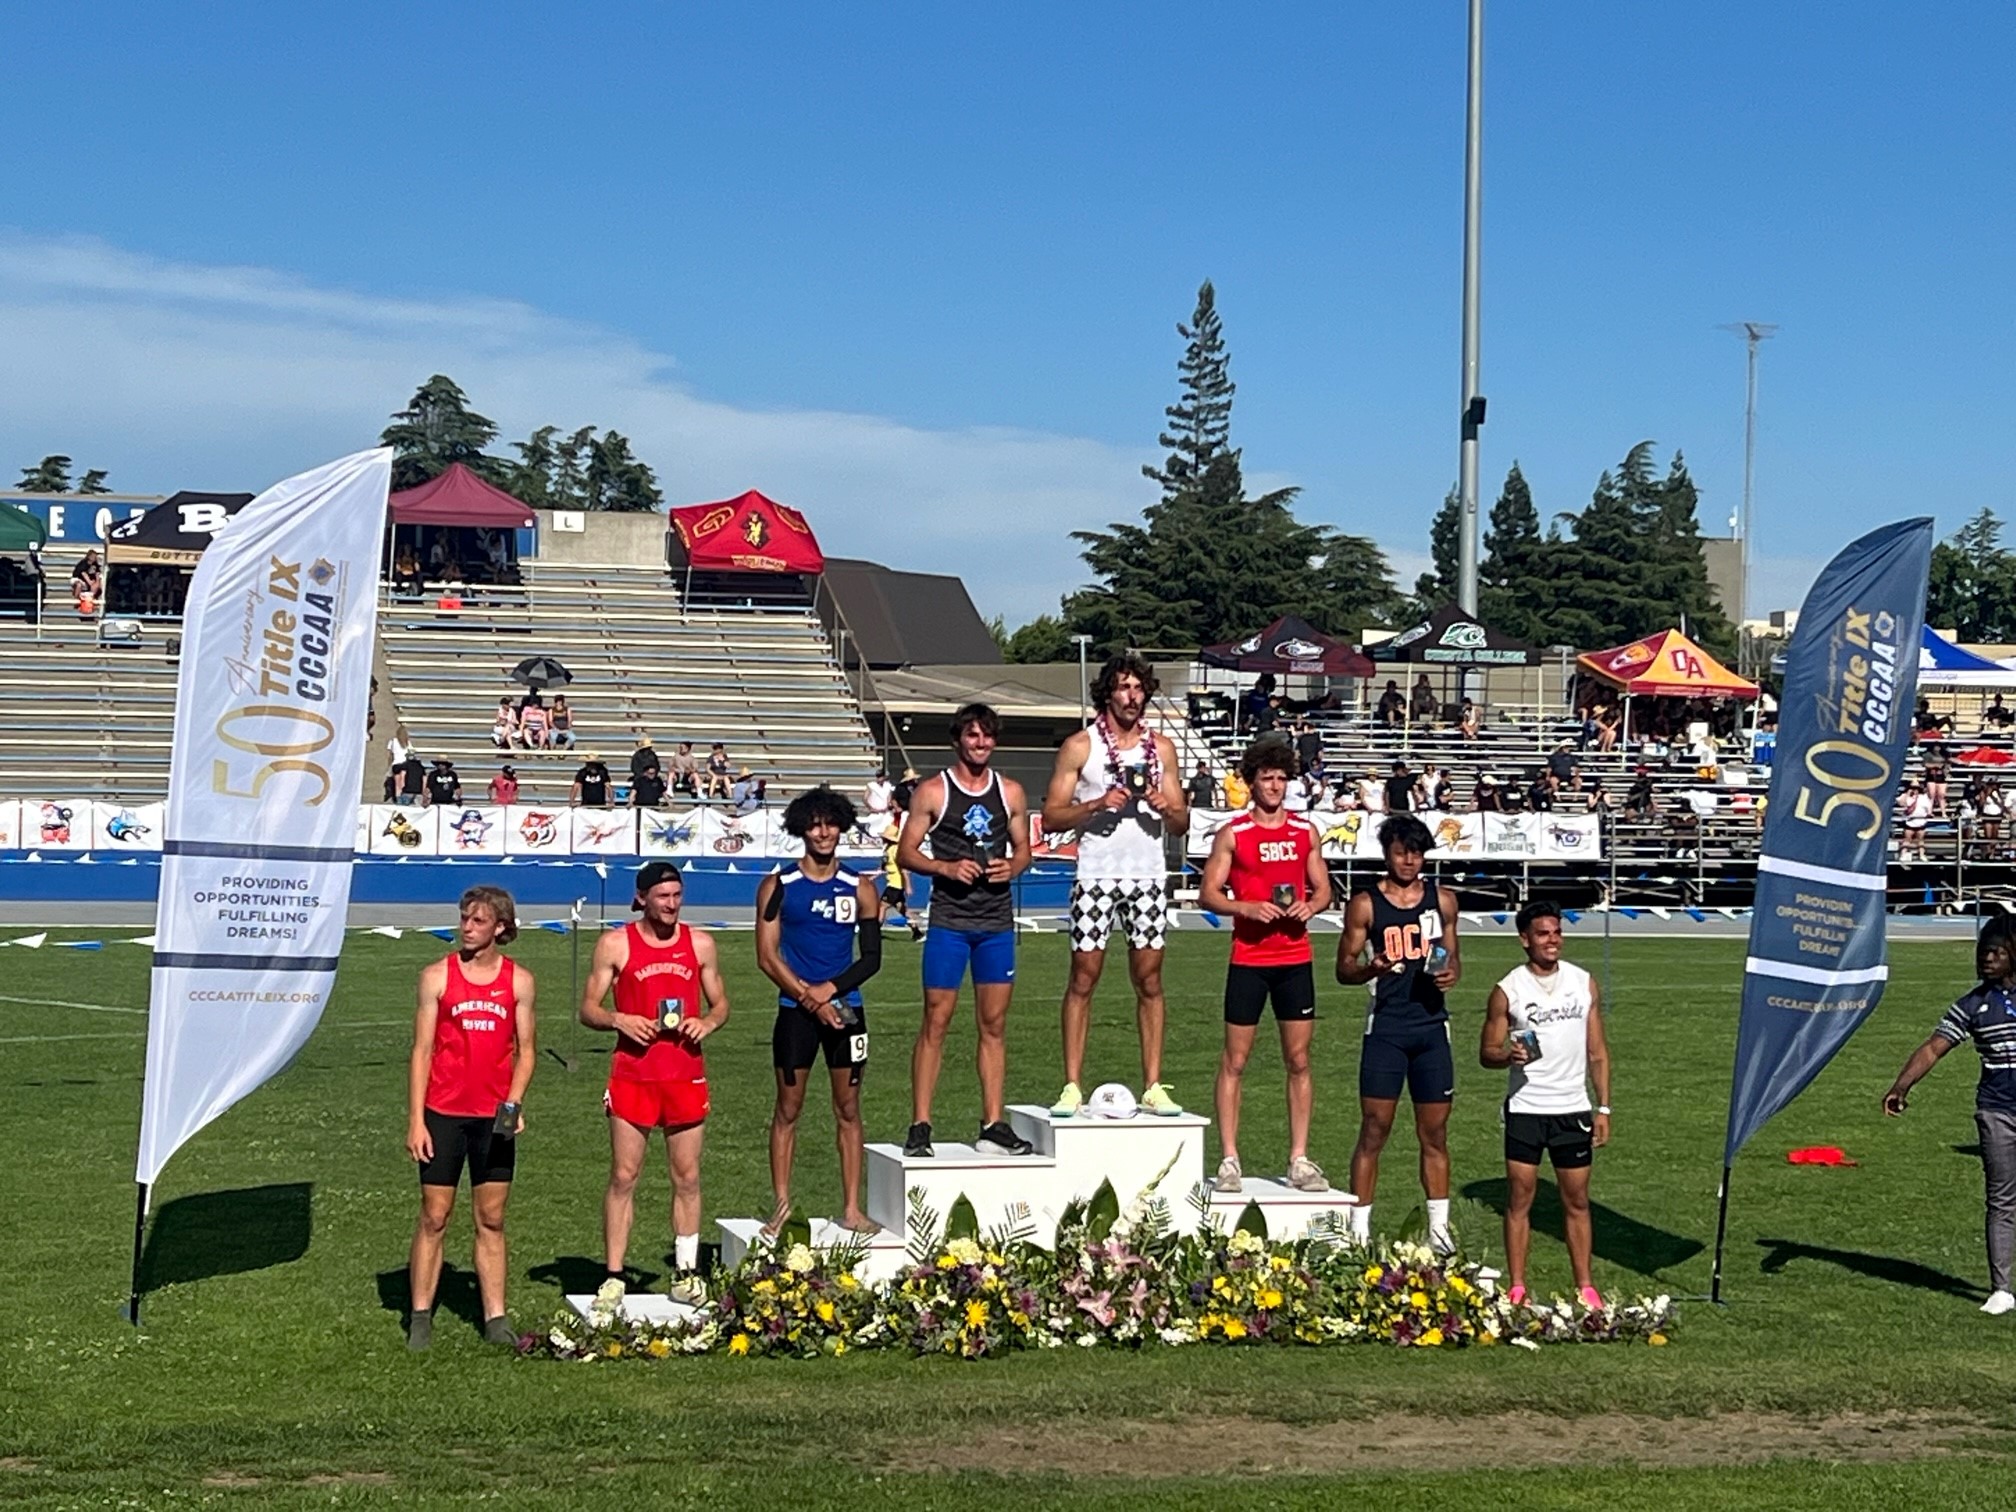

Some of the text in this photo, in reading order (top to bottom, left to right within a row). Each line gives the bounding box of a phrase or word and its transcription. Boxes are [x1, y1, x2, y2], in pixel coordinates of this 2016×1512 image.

[260, 554, 302, 697] Title IX
[296, 592, 334, 702] CCCAA
[1839, 606, 1871, 735] Title IX
[1862, 640, 1896, 744] CCCAA
[212, 705, 335, 807] 50
[1793, 739, 1891, 841] 50
[1258, 840, 1299, 863] SBCC
[222, 876, 308, 891] PROVIDING
[194, 891, 320, 908] OPPORTUNITIES
[841, 899, 852, 921] 9
[218, 909, 308, 924] FULFILLING
[1423, 914, 1434, 936] 7
[227, 926, 297, 940] DREAMS!
[188, 990, 321, 1004] CCCAATITLEIX.ORG
[855, 1037, 866, 1059] 9
